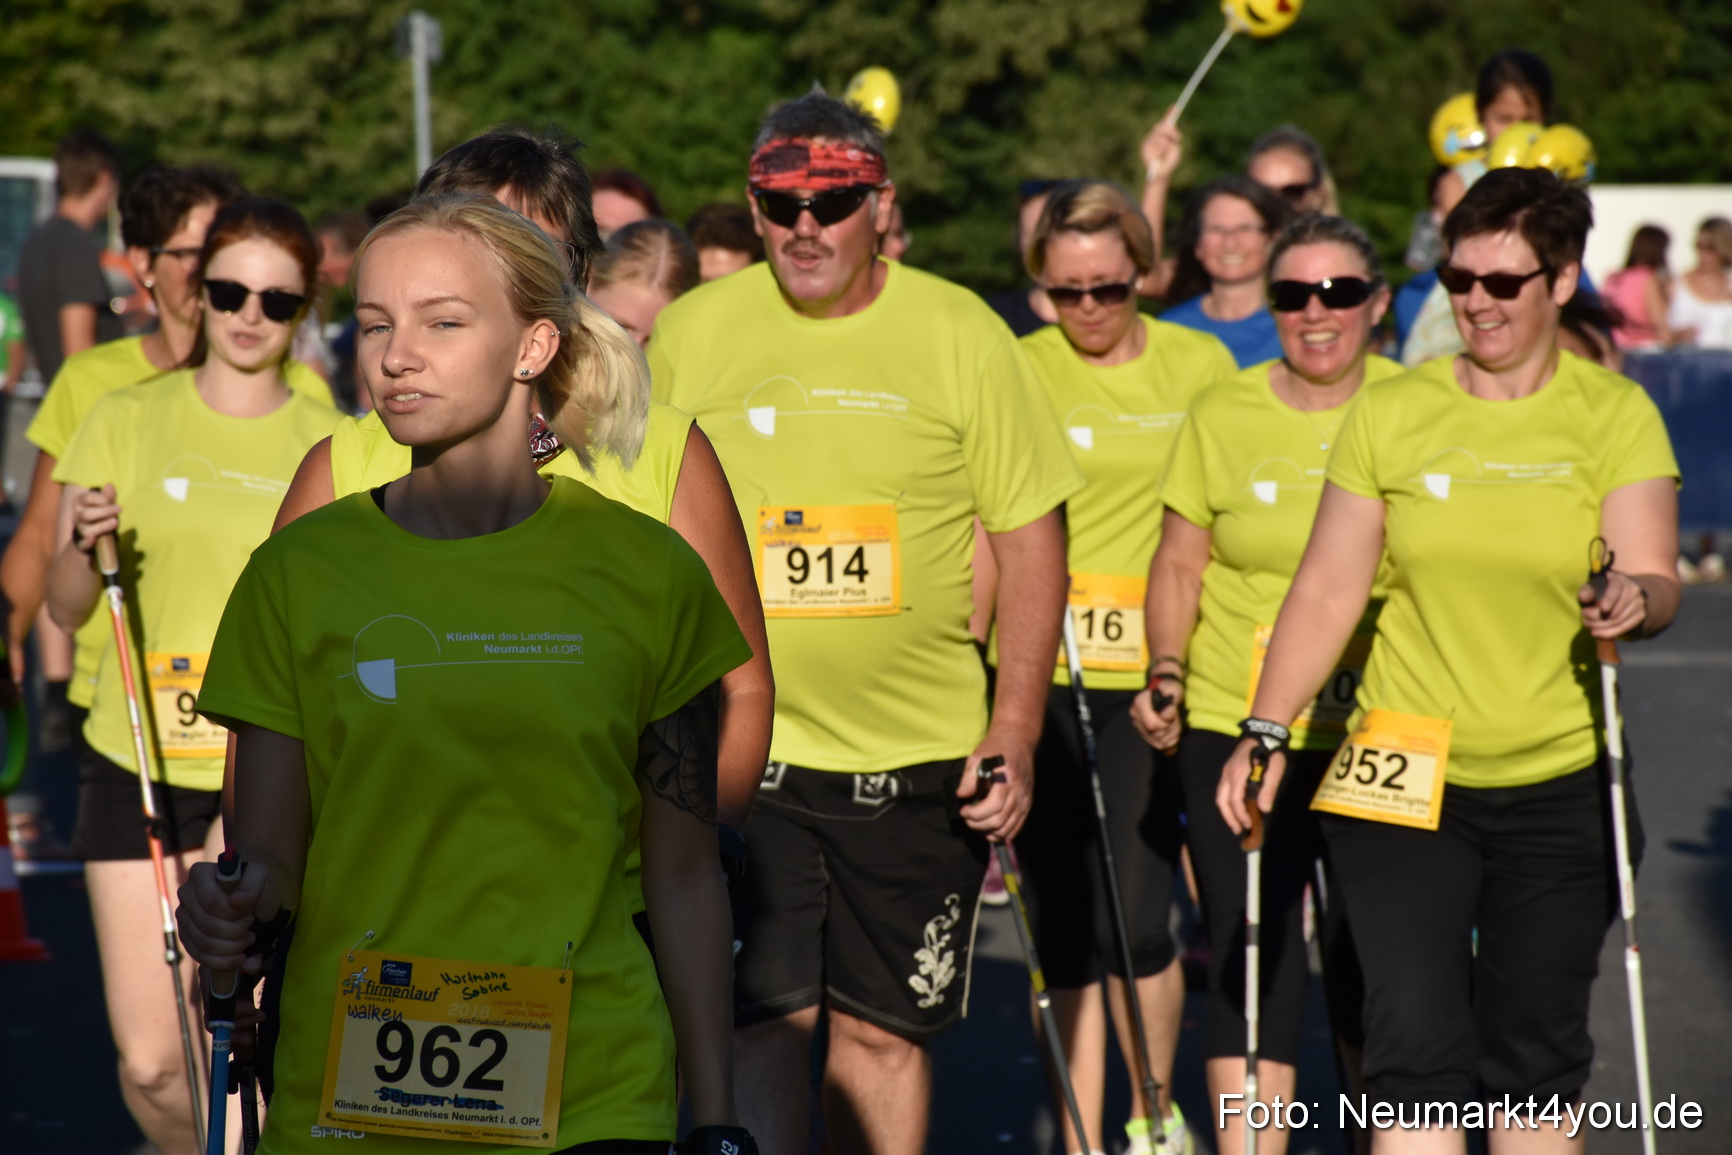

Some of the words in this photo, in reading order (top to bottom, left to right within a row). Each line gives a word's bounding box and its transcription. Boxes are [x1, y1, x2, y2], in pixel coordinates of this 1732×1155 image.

[787, 546, 869, 585] 914
[446, 632, 495, 642] Kliniken
[498, 632, 518, 641] des
[521, 631, 583, 642] Landkreises
[1073, 608, 1123, 641] 16
[484, 644, 542, 654] Neumarkt
[1335, 745, 1408, 790] 952
[364, 980, 441, 1002] firmenlauf
[440, 971, 506, 986] Hartmann
[447, 1003, 491, 1018] 2018
[374, 1020, 509, 1092] 962
[334, 1099, 369, 1112] Kliniken
[371, 1105, 388, 1114] des
[391, 1106, 449, 1120] Landkreises
[451, 1112, 498, 1124] Neumarkt
[500, 1116, 506, 1124] i.
[509, 1116, 518, 1125] d.
[521, 1116, 542, 1127] OPf.
